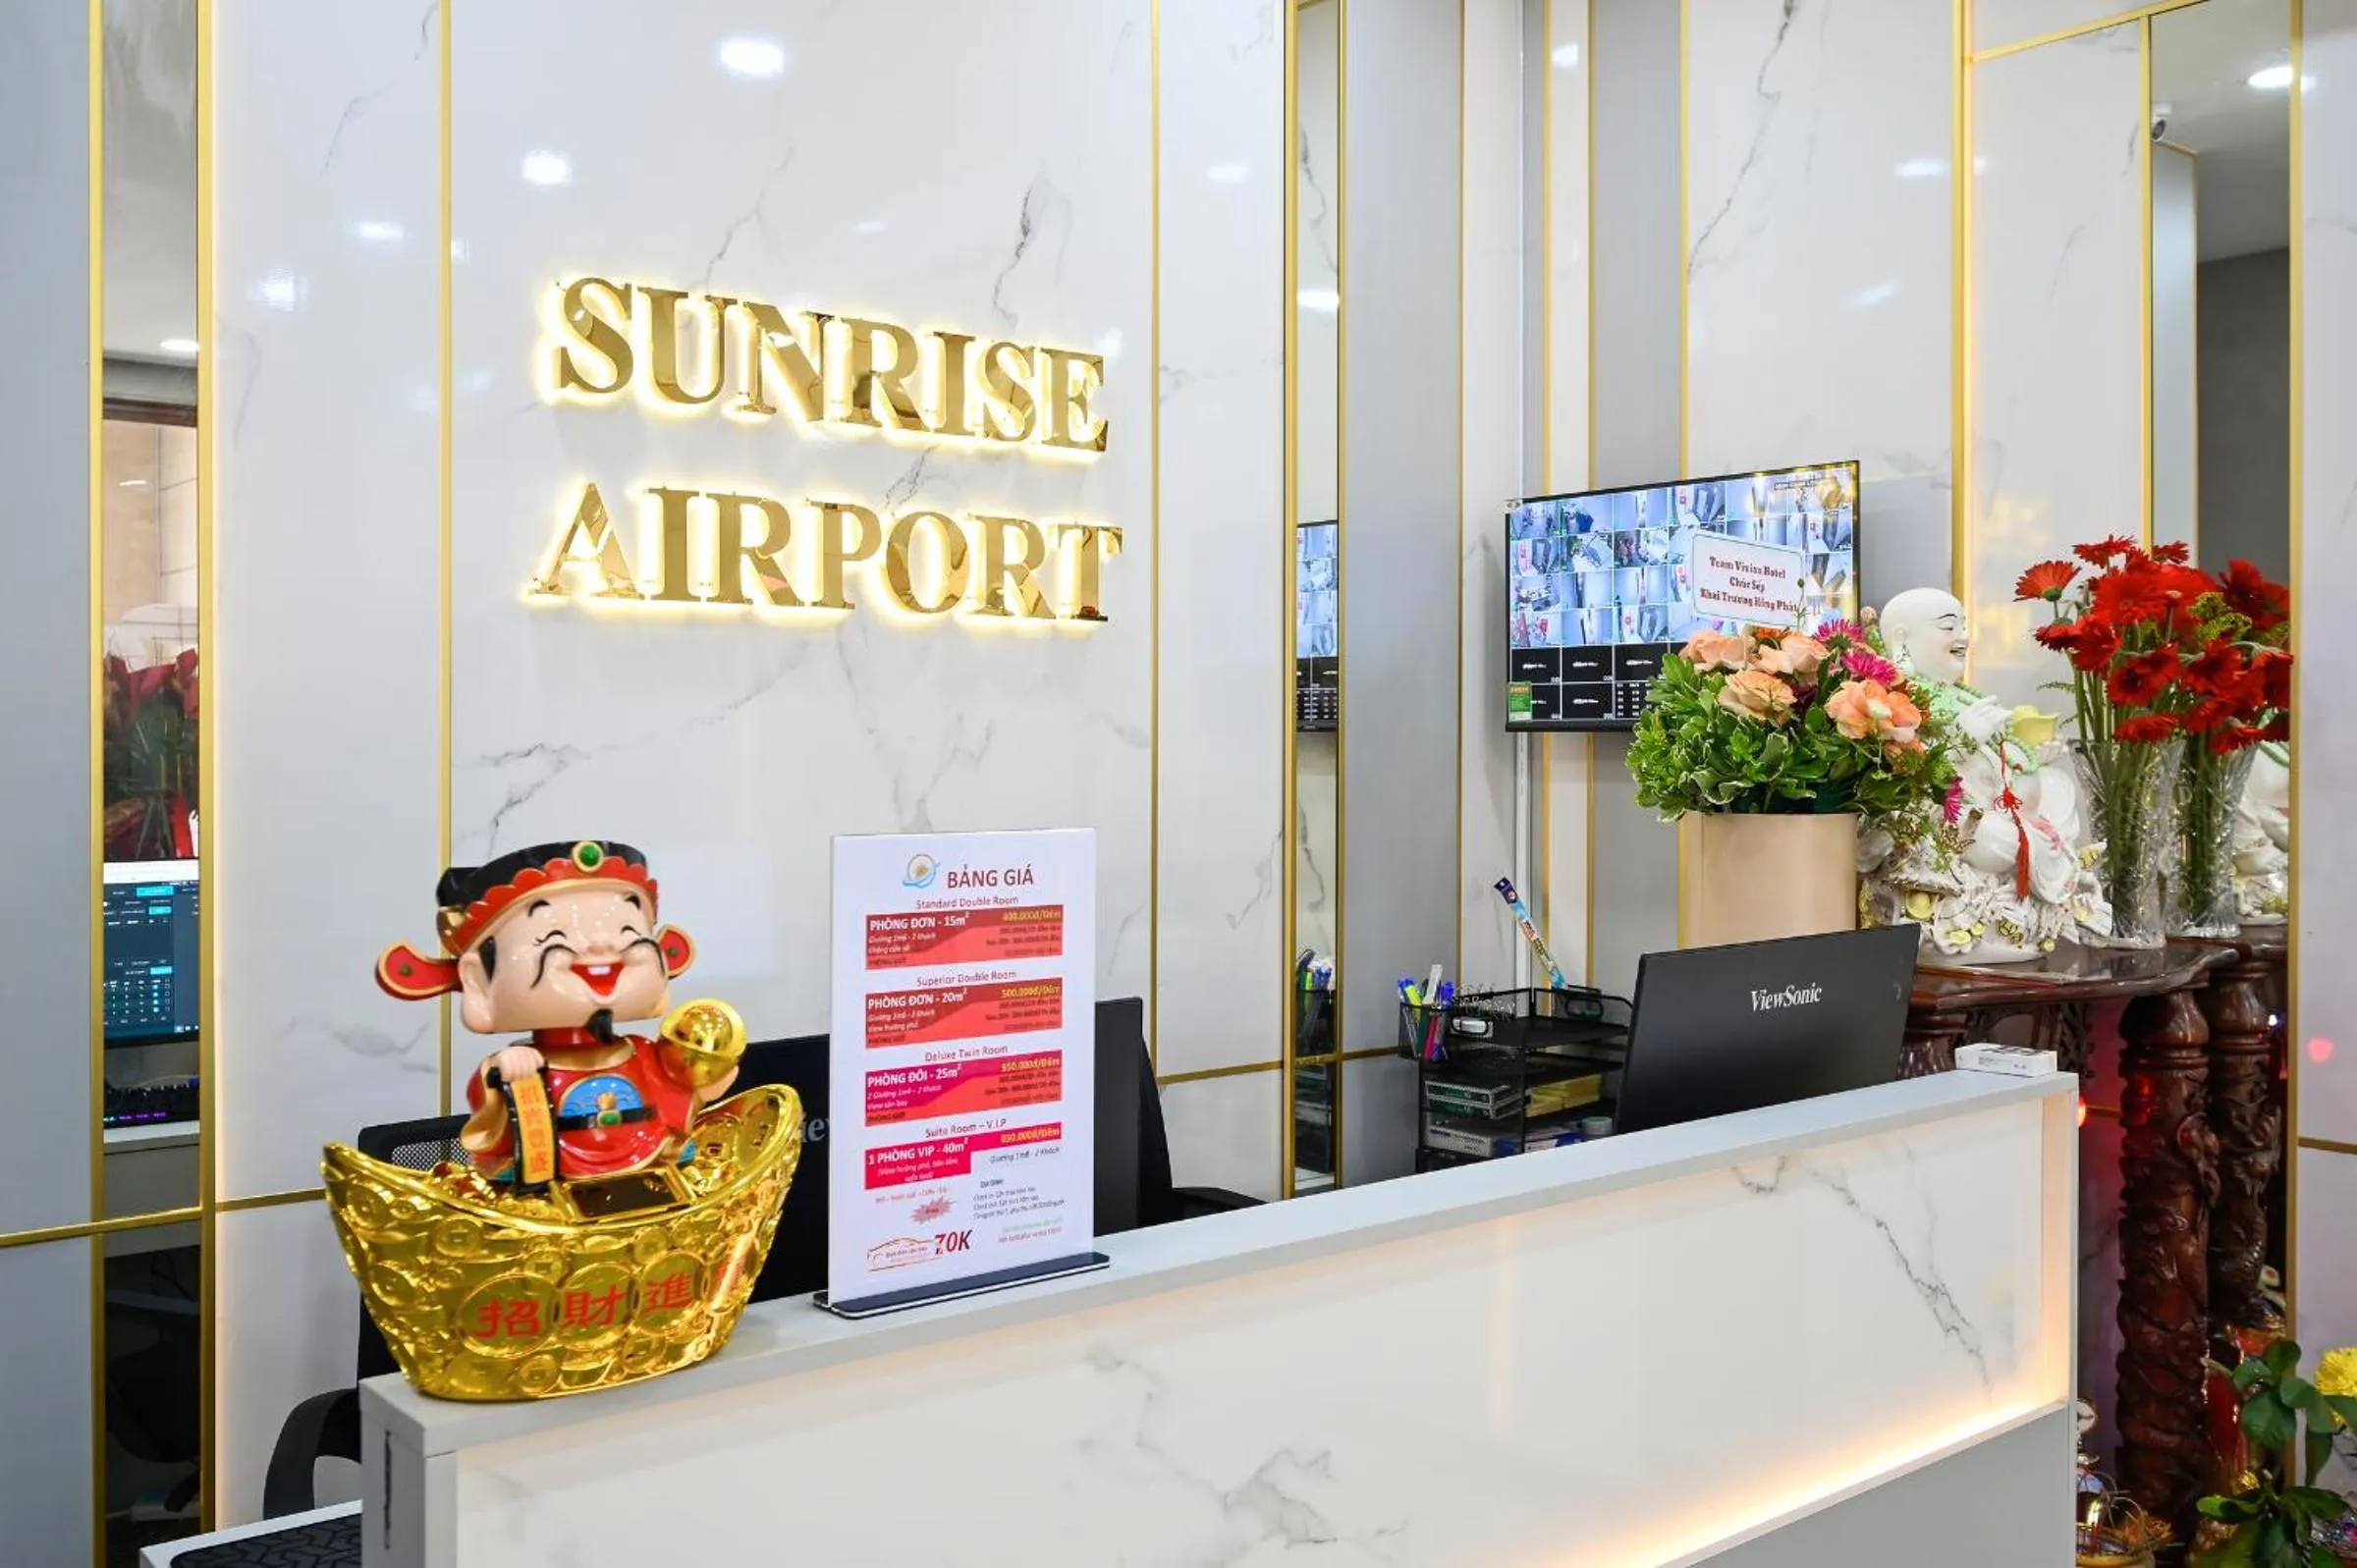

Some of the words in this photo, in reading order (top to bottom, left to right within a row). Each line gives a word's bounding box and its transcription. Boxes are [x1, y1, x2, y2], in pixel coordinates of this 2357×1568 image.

[557, 277, 1108, 452] SUNRISE
[527, 483, 1122, 622] AIRPORT
[1710, 556, 1733, 569] Team
[1764, 566, 1785, 578] Hotel
[1700, 588, 1720, 601] Khai
[948, 864, 998, 889] BẢNG
[1004, 864, 1034, 886] GIÁ
[915, 897, 958, 909] Standard
[959, 895, 991, 907] Double
[993, 894, 1019, 904] Room
[870, 916, 908, 932] PHÒNG
[910, 917, 936, 929] ĐƠN
[916, 975, 956, 987] Superior
[958, 971, 990, 982] Double
[991, 970, 1017, 980] Room
[868, 995, 906, 1009] PHÒNG
[908, 994, 934, 1006] ĐƠN
[1750, 982, 1823, 1012] ViewSonic
[924, 1051, 957, 1061] Deluxe
[959, 1048, 980, 1057] Twin
[982, 1045, 1008, 1054] Room
[868, 1072, 906, 1087] PHÒNG
[908, 1068, 928, 1083] ĐÔI
[925, 1127, 948, 1138] Suite
[951, 1124, 976, 1134] Room
[986, 1117, 1007, 1129] V.I.P
[868, 1155, 875, 1165] 1
[877, 1148, 915, 1163] PHÒNG
[917, 1145, 935, 1158] VIP
[934, 1229, 973, 1256] 70K
